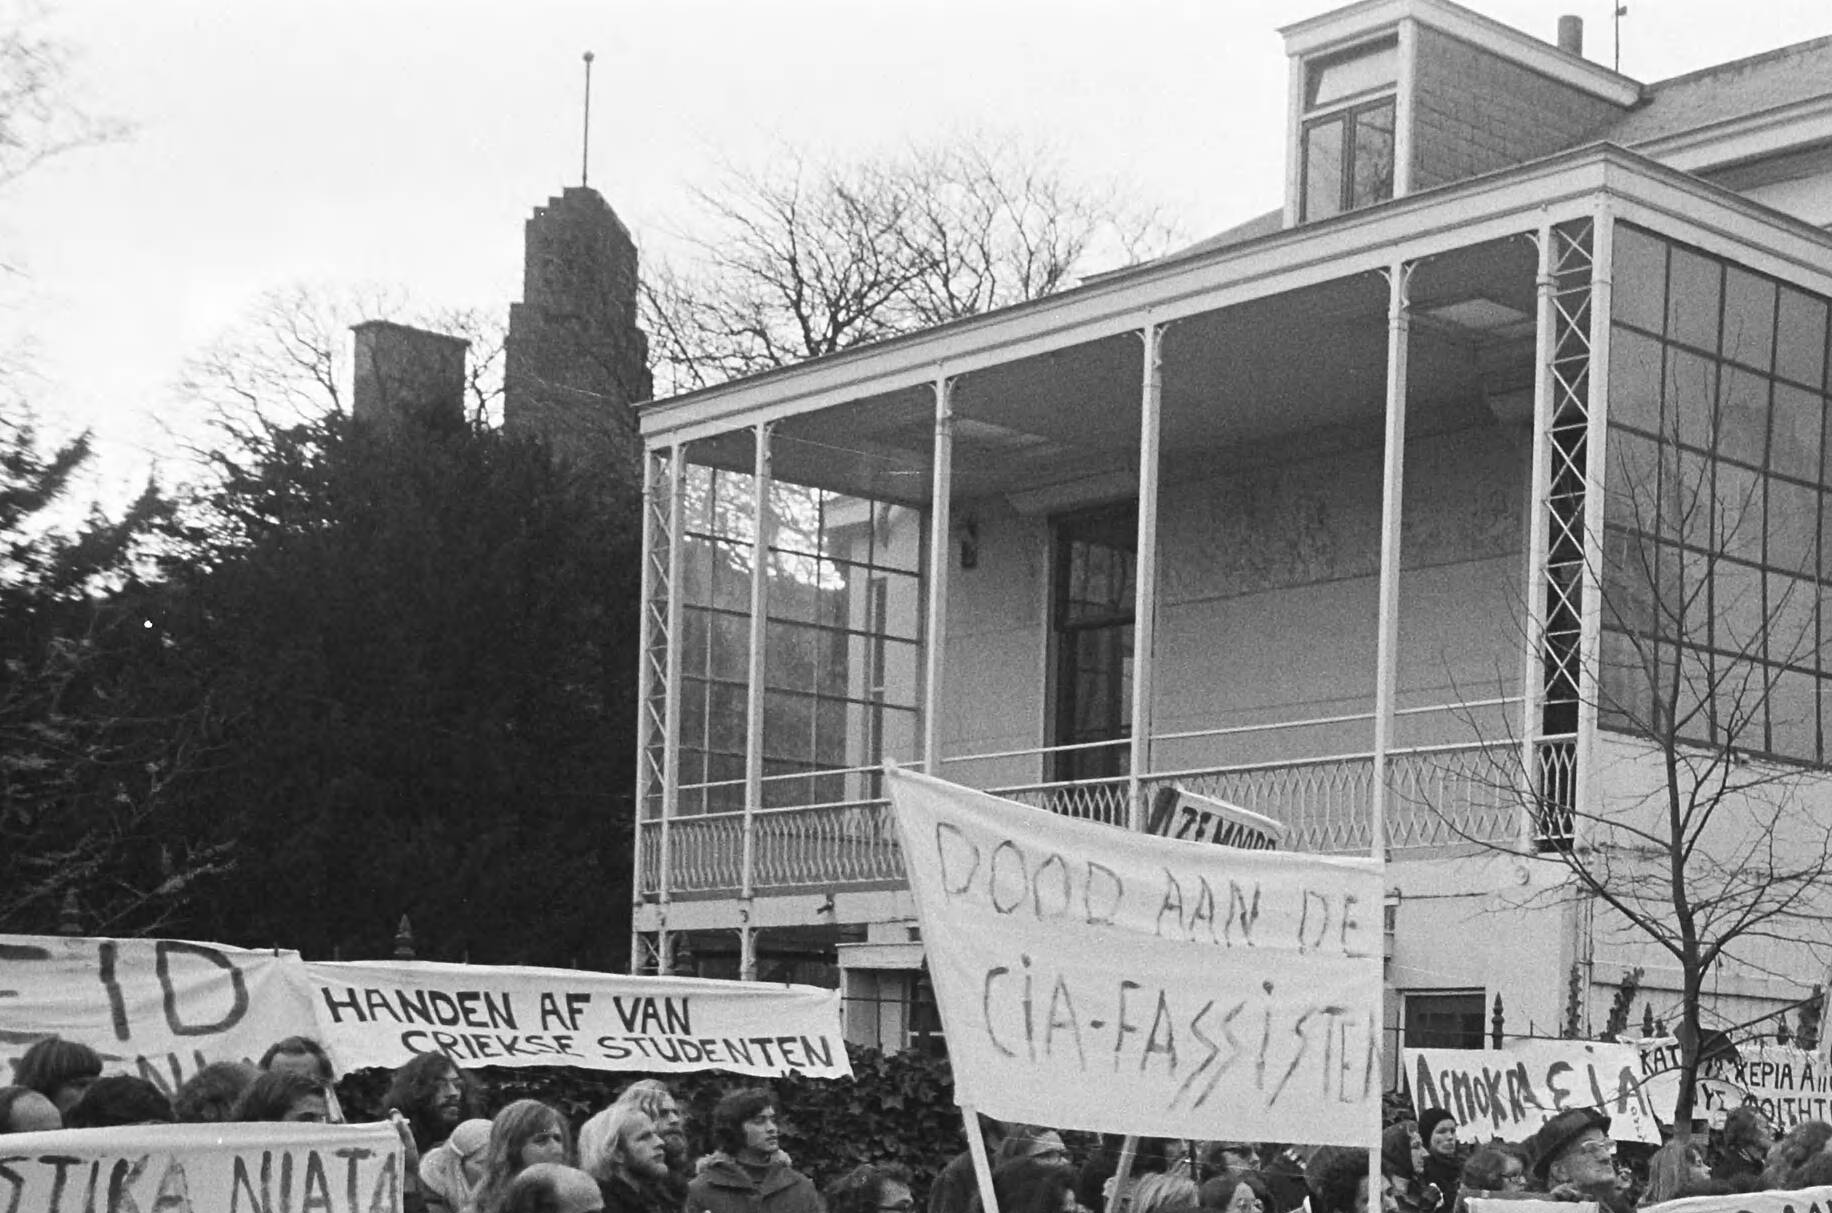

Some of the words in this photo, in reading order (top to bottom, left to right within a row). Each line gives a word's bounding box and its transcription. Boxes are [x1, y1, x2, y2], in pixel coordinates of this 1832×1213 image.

[936, 821, 1124, 927] DOOD
[1157, 867, 1261, 949] AAN
[1297, 888, 1378, 958] DE
[321, 987, 519, 1030] HANDEN
[540, 992, 592, 1031] AF
[612, 995, 692, 1036] VAN
[597, 1035, 835, 1068] STUDENTEN
